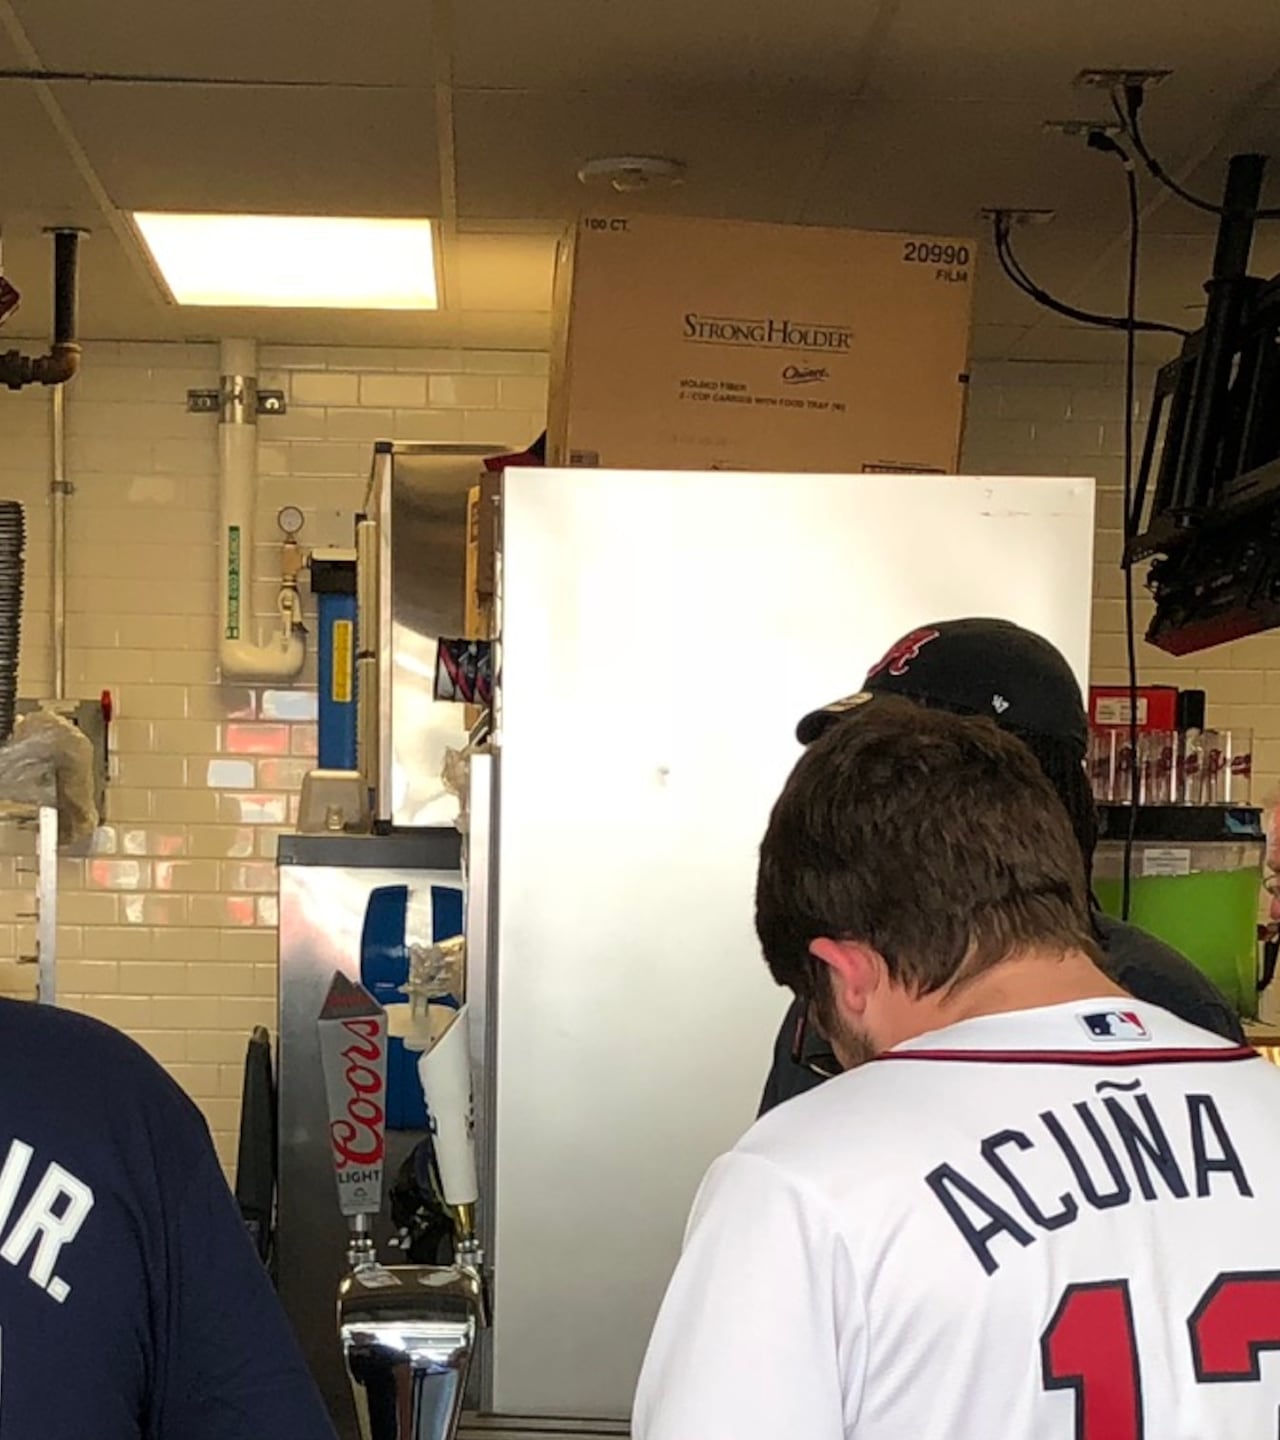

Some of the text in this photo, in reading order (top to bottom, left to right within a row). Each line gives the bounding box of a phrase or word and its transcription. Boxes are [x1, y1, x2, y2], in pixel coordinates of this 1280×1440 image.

[904, 242, 970, 266] 20990
[936, 269, 969, 283] FILM
[330, 1019, 385, 1170] Coors
[338, 1169, 380, 1184] LIGHT
[925, 1078, 1254, 1276] ACUÑA
